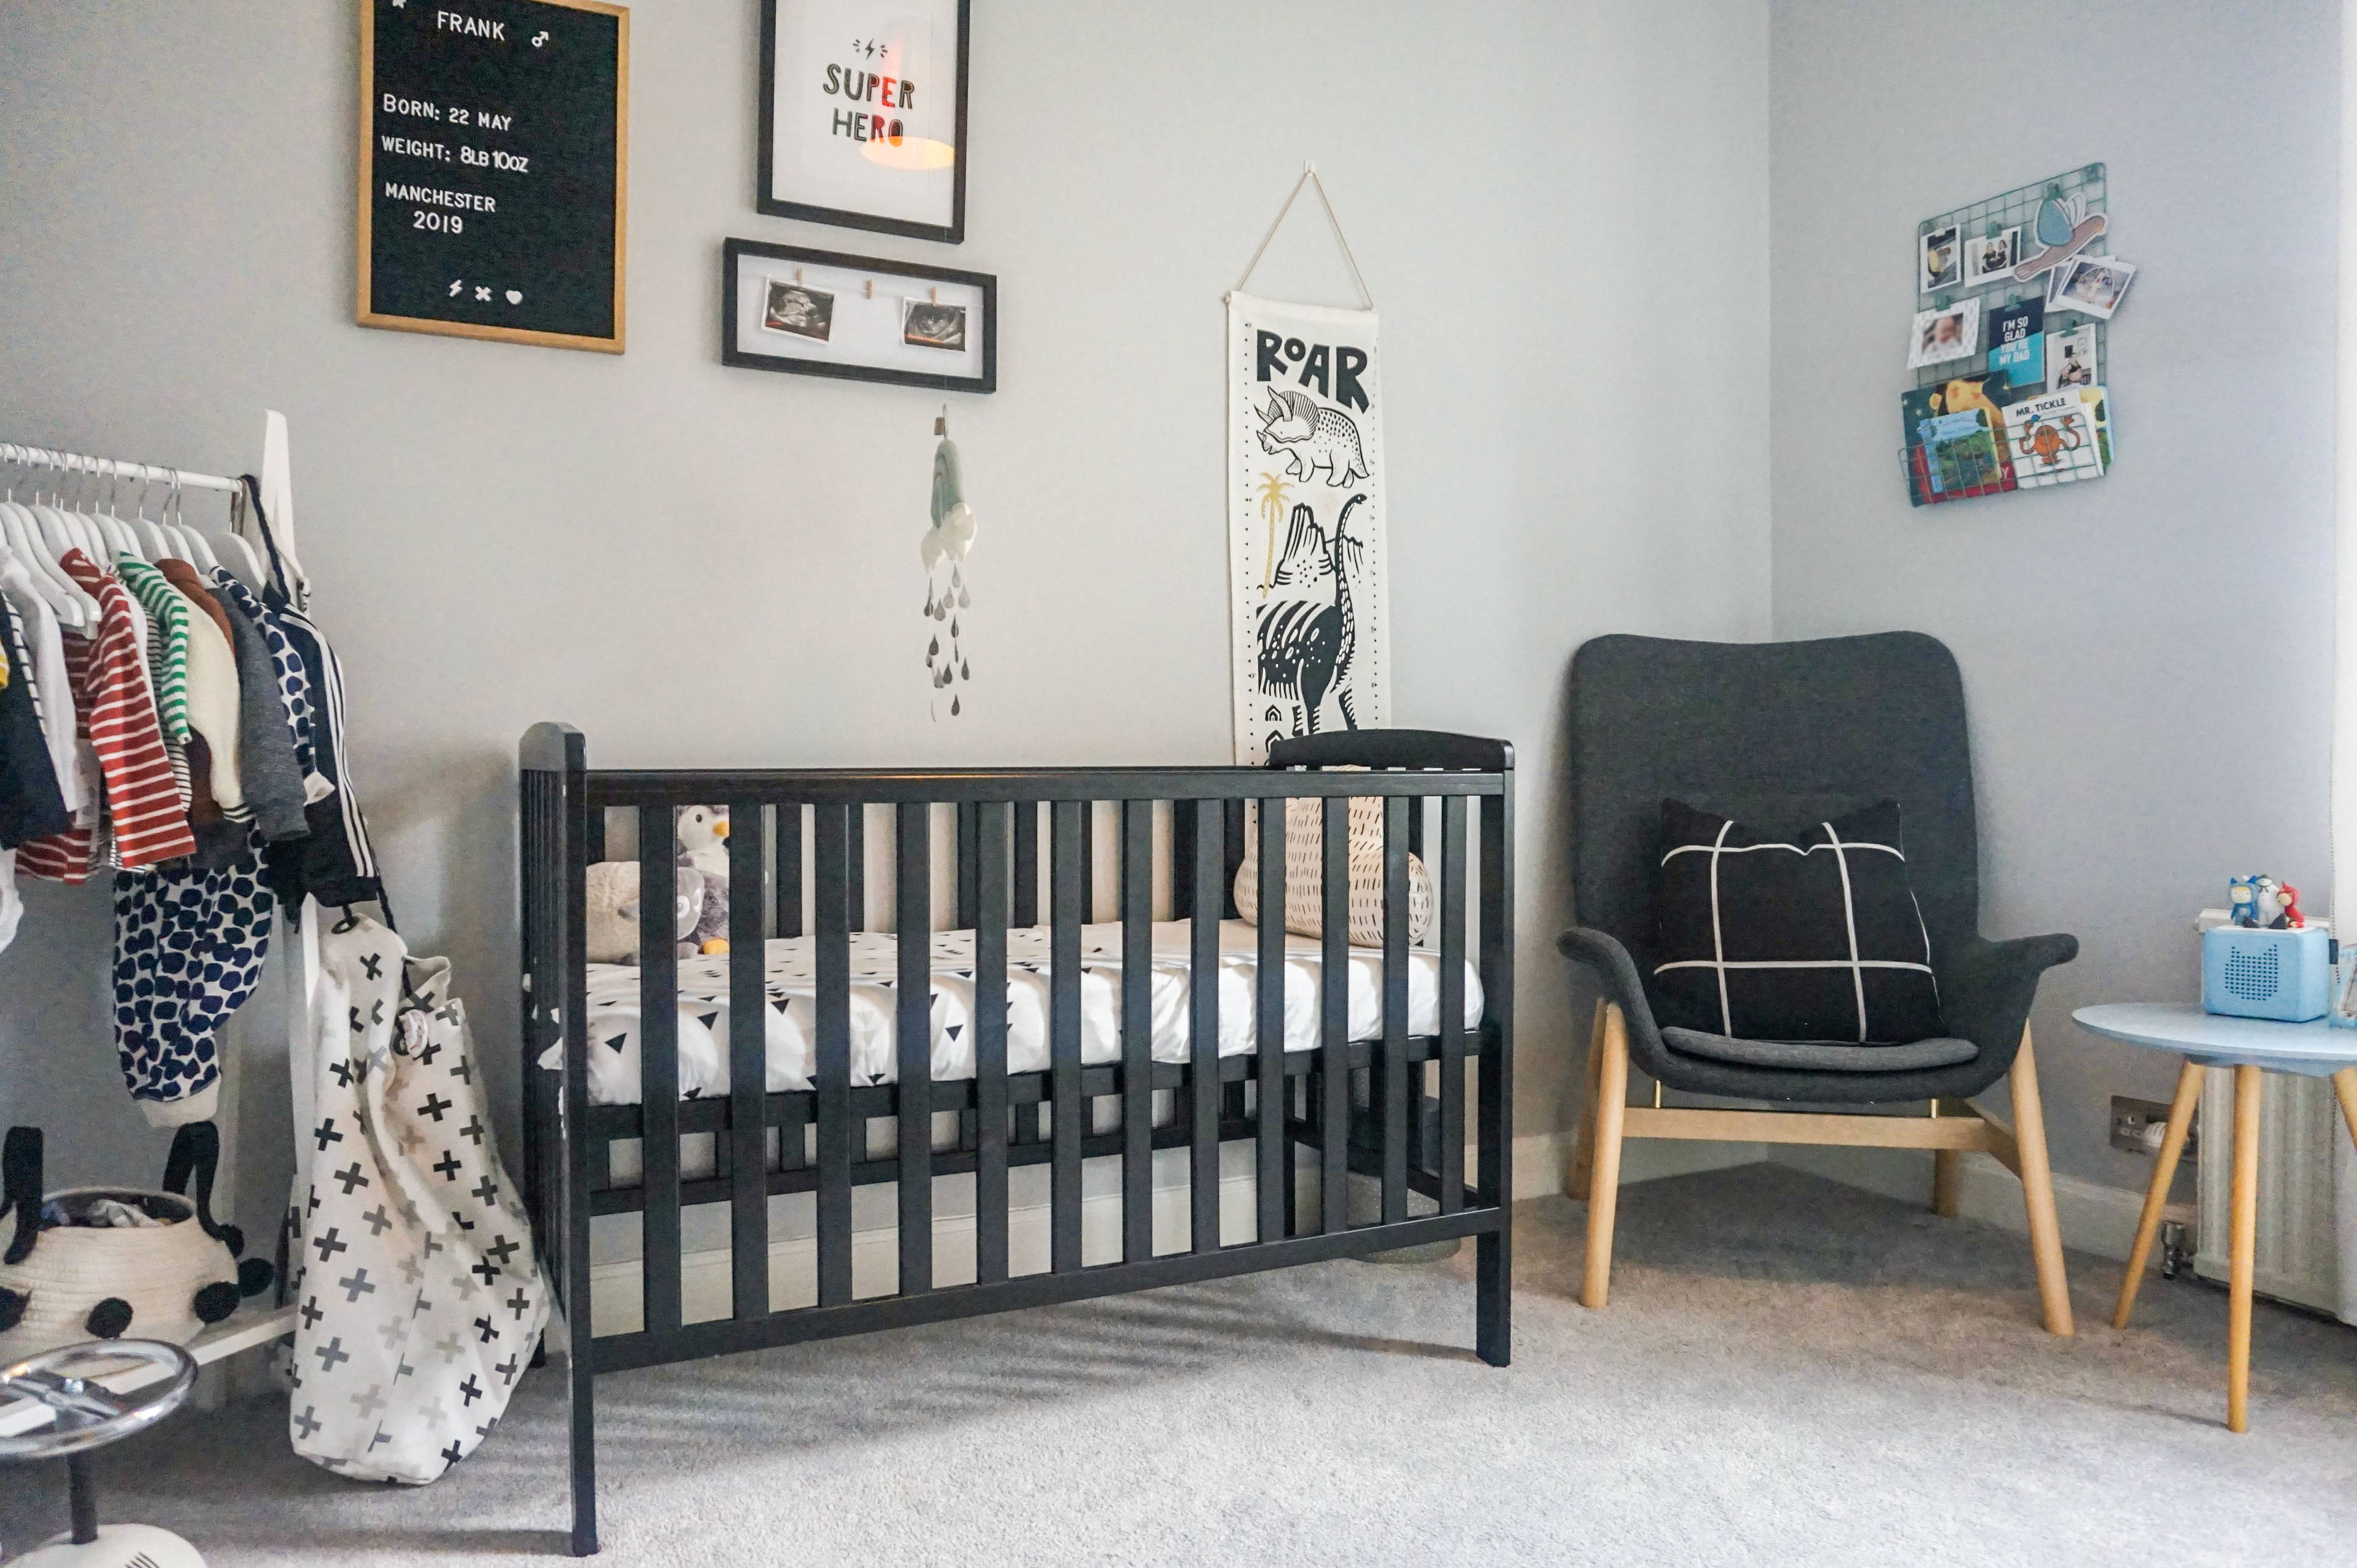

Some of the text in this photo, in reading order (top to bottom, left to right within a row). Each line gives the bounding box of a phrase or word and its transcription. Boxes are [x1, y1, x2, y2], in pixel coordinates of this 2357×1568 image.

[438, 11, 505, 41] FRANK
[822, 63, 915, 109] SUPER
[383, 94, 512, 131] BORN: 22 MAY
[832, 107, 904, 147] HERO
[382, 136, 451, 162] WEIGHT:
[385, 182, 496, 213] MANCHESTER
[413, 210, 463, 234] 2019
[2003, 315, 2029, 332] I'M SO
[2004, 328, 2026, 342] GLAD
[2000, 337, 2029, 354] YOU'RE
[2013, 349, 2030, 364] DAD
[1256, 329, 1370, 414] ROAR
[2016, 406, 2034, 417] MR.
[2035, 398, 2067, 412] TICKLE
